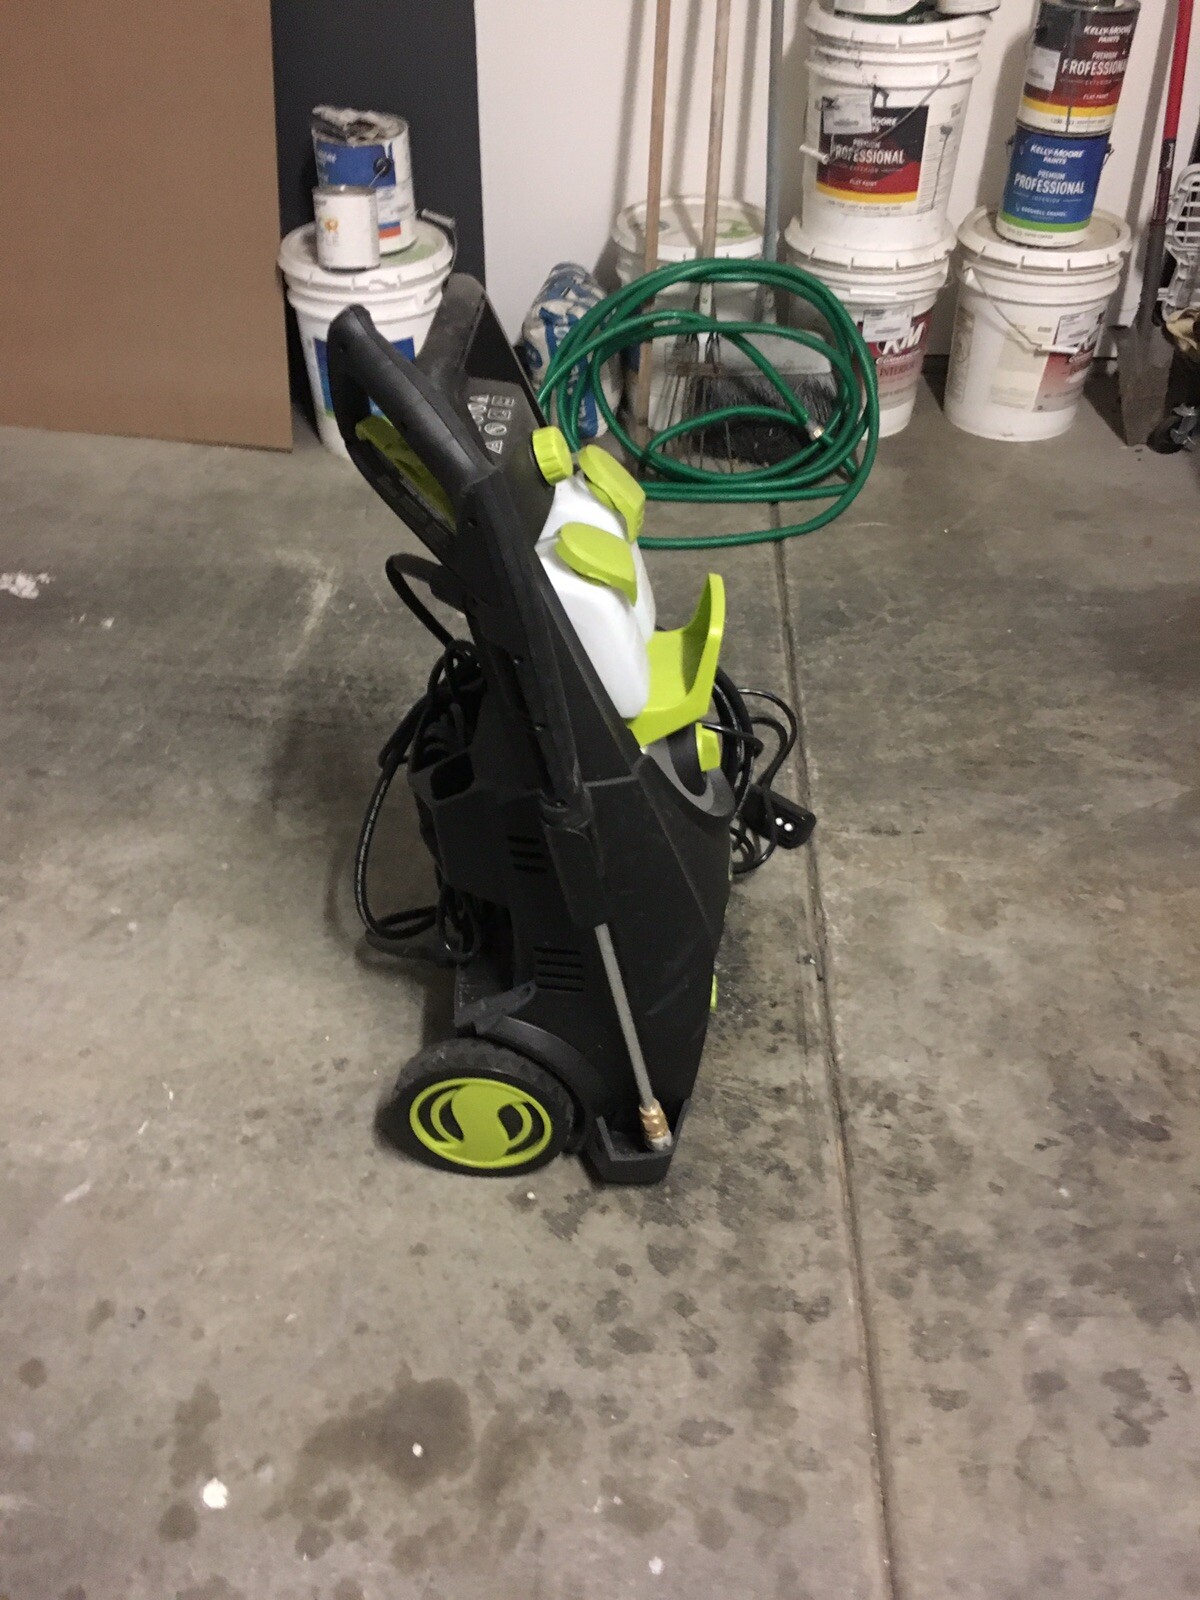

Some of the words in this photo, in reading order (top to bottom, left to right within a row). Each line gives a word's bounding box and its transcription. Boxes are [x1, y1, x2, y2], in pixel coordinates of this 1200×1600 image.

[1092, 51, 1118, 60] PREMIUM
[830, 142, 905, 165] PROFESSIONAL
[1031, 144, 1085, 158] KELLY-MOORE
[1043, 157, 1067, 165] PAINTS
[1038, 170, 1066, 181] PREMIUM
[1013, 172, 1085, 195] PROFESSIONAL
